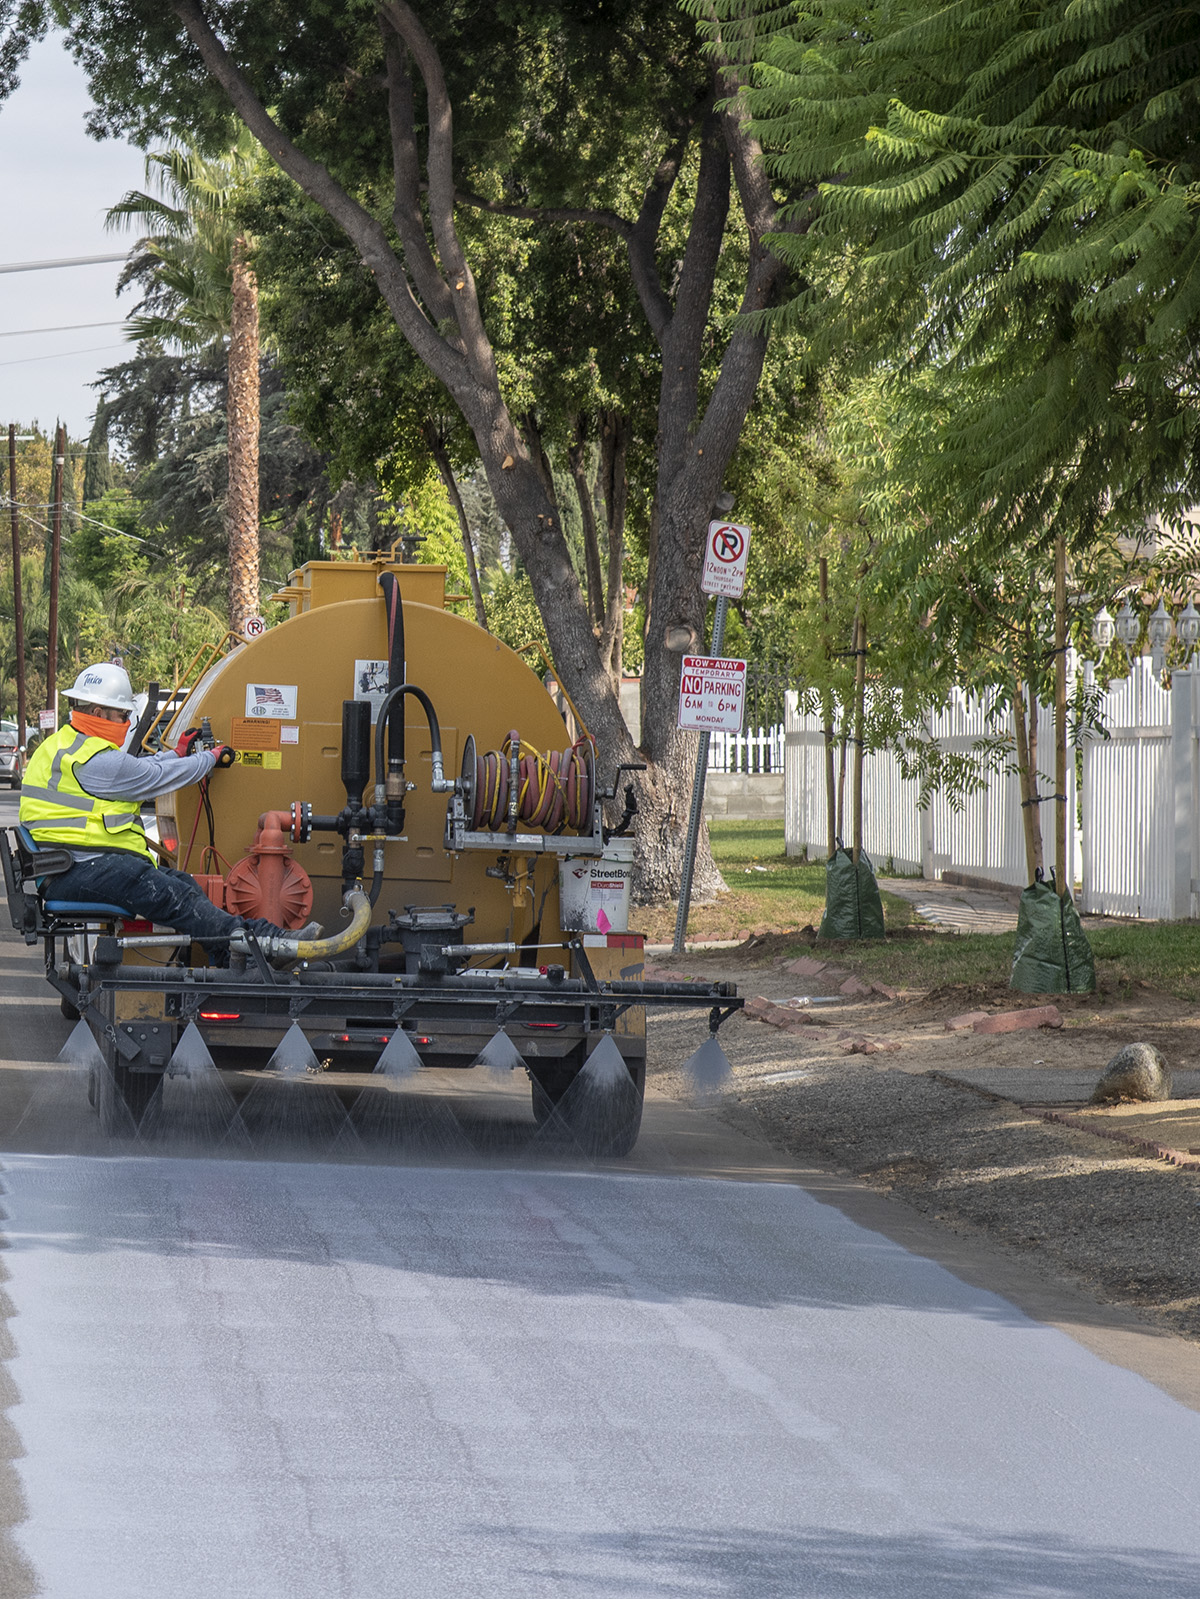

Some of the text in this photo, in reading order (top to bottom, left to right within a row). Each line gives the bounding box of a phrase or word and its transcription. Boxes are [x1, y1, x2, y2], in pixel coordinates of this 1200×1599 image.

[732, 566, 744, 578] 2PM
[691, 668, 736, 678] TEMPORARY
[684, 677, 741, 697] NO PARKING
[684, 696, 702, 709] 6AM
[718, 698, 737, 712] 6PM
